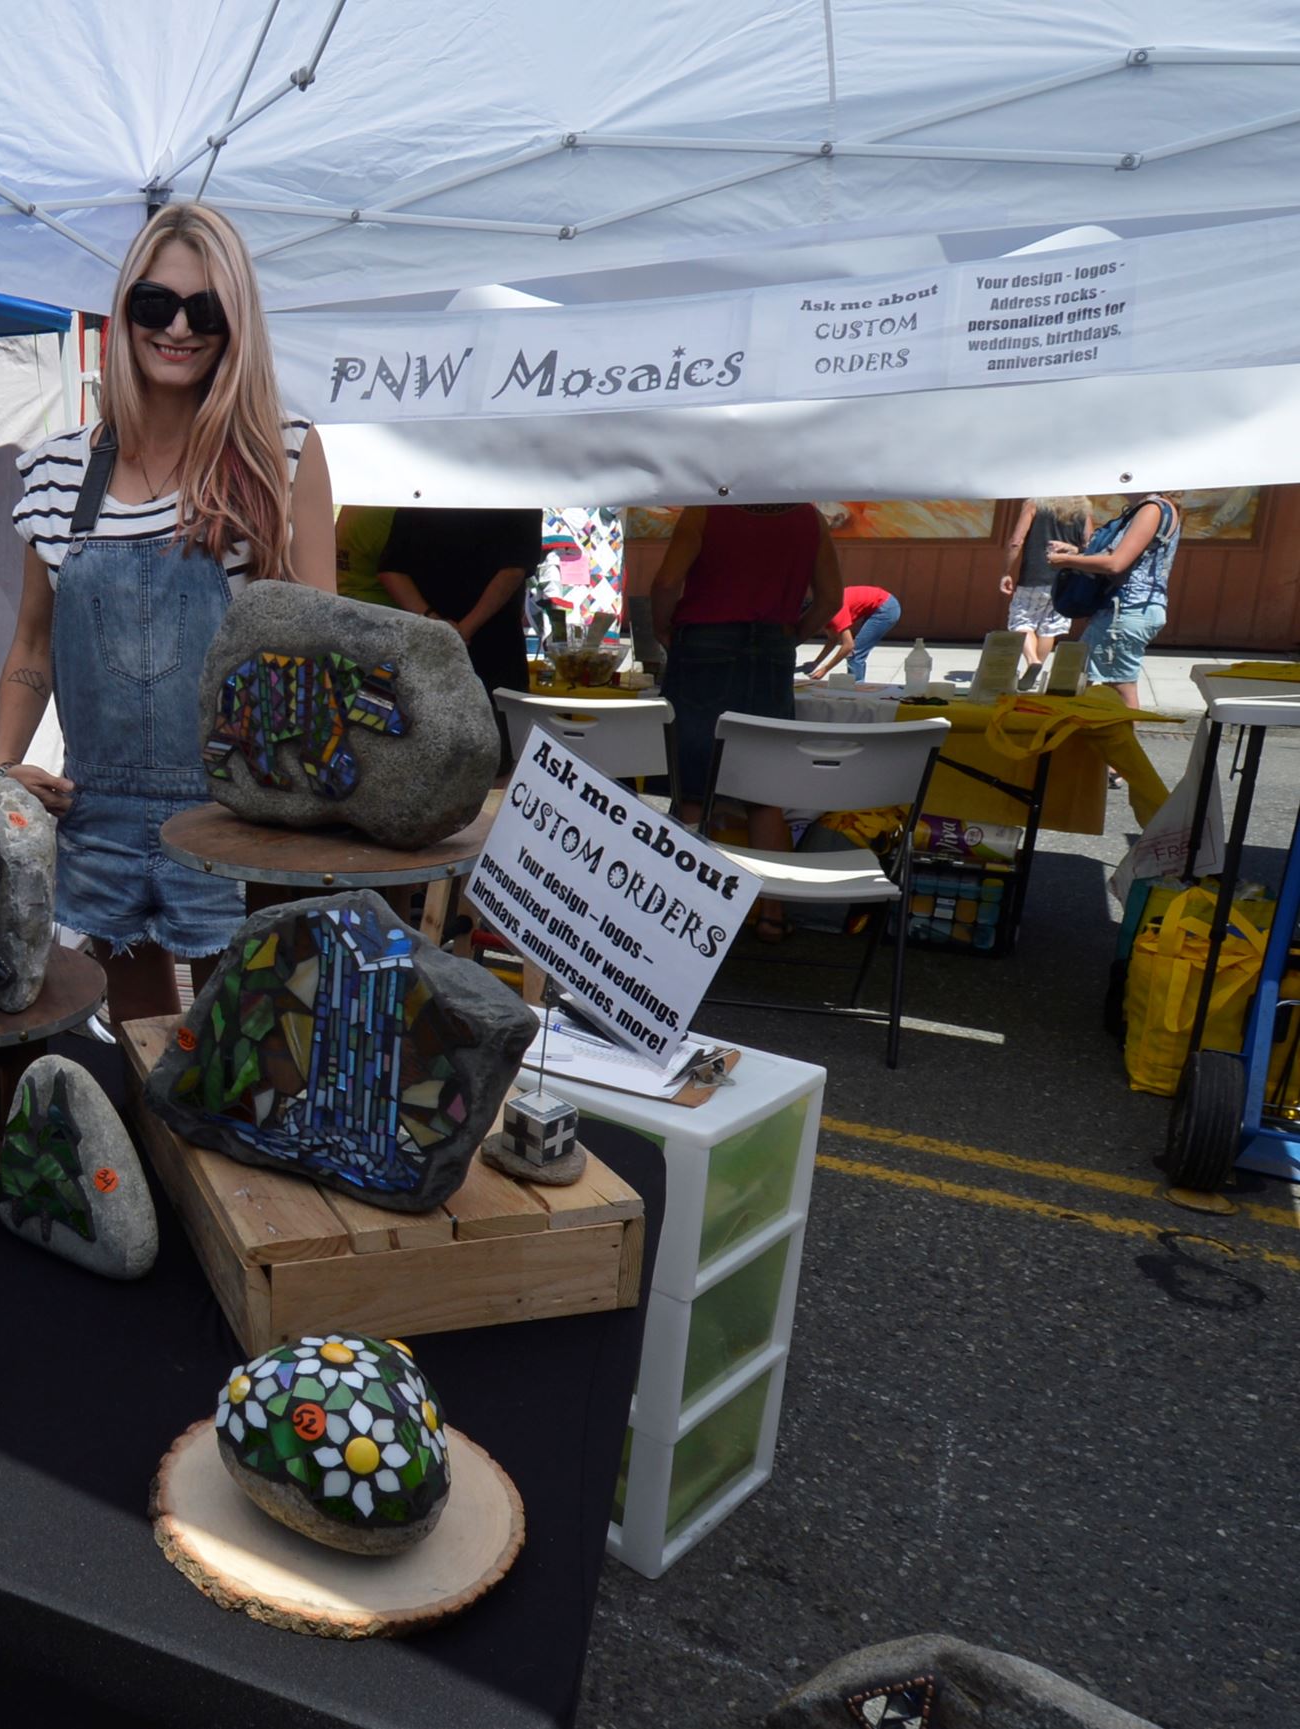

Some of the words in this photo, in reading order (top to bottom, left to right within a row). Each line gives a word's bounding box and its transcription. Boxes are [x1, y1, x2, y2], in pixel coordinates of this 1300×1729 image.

[975, 275, 1009, 290] Your
[1011, 271, 1062, 288] design
[1074, 262, 1117, 281] logos
[800, 299, 836, 312] Ask
[841, 298, 873, 311] me
[878, 284, 938, 308] about
[989, 295, 1051, 311] Address
[1054, 287, 1096, 305] rocks
[815, 312, 918, 341] CUSTOM
[968, 312, 1064, 332] personalized
[1067, 306, 1101, 322] gifts
[1104, 301, 1126, 317] for
[968, 336, 1043, 351] weddings,
[1046, 324, 1122, 346] birthdays,
[814, 348, 910, 374] ORDERS
[987, 347, 1098, 371] anniversaries!
[330, 347, 474, 403] PNW
[492, 344, 745, 399] Mosaics
[532, 740, 578, 791] Ask
[579, 781, 627, 825] me
[632, 819, 741, 900] about
[511, 780, 605, 874] CUSTOM
[607, 860, 728, 960] ORDERS
[517, 846, 544, 880] Your
[542, 871, 589, 918] design
[599, 914, 642, 960] logos
[480, 853, 550, 925] personalized
[547, 914, 580, 951] gifts
[580, 940, 603, 968] for
[601, 959, 680, 1032] weddings,
[472, 876, 520, 938] birthdays,
[521, 929, 614, 1018] anniversaries,
[615, 1008, 669, 1055] more!
[97, 1169, 116, 1192] 34
[292, 1408, 318, 1435] 52
